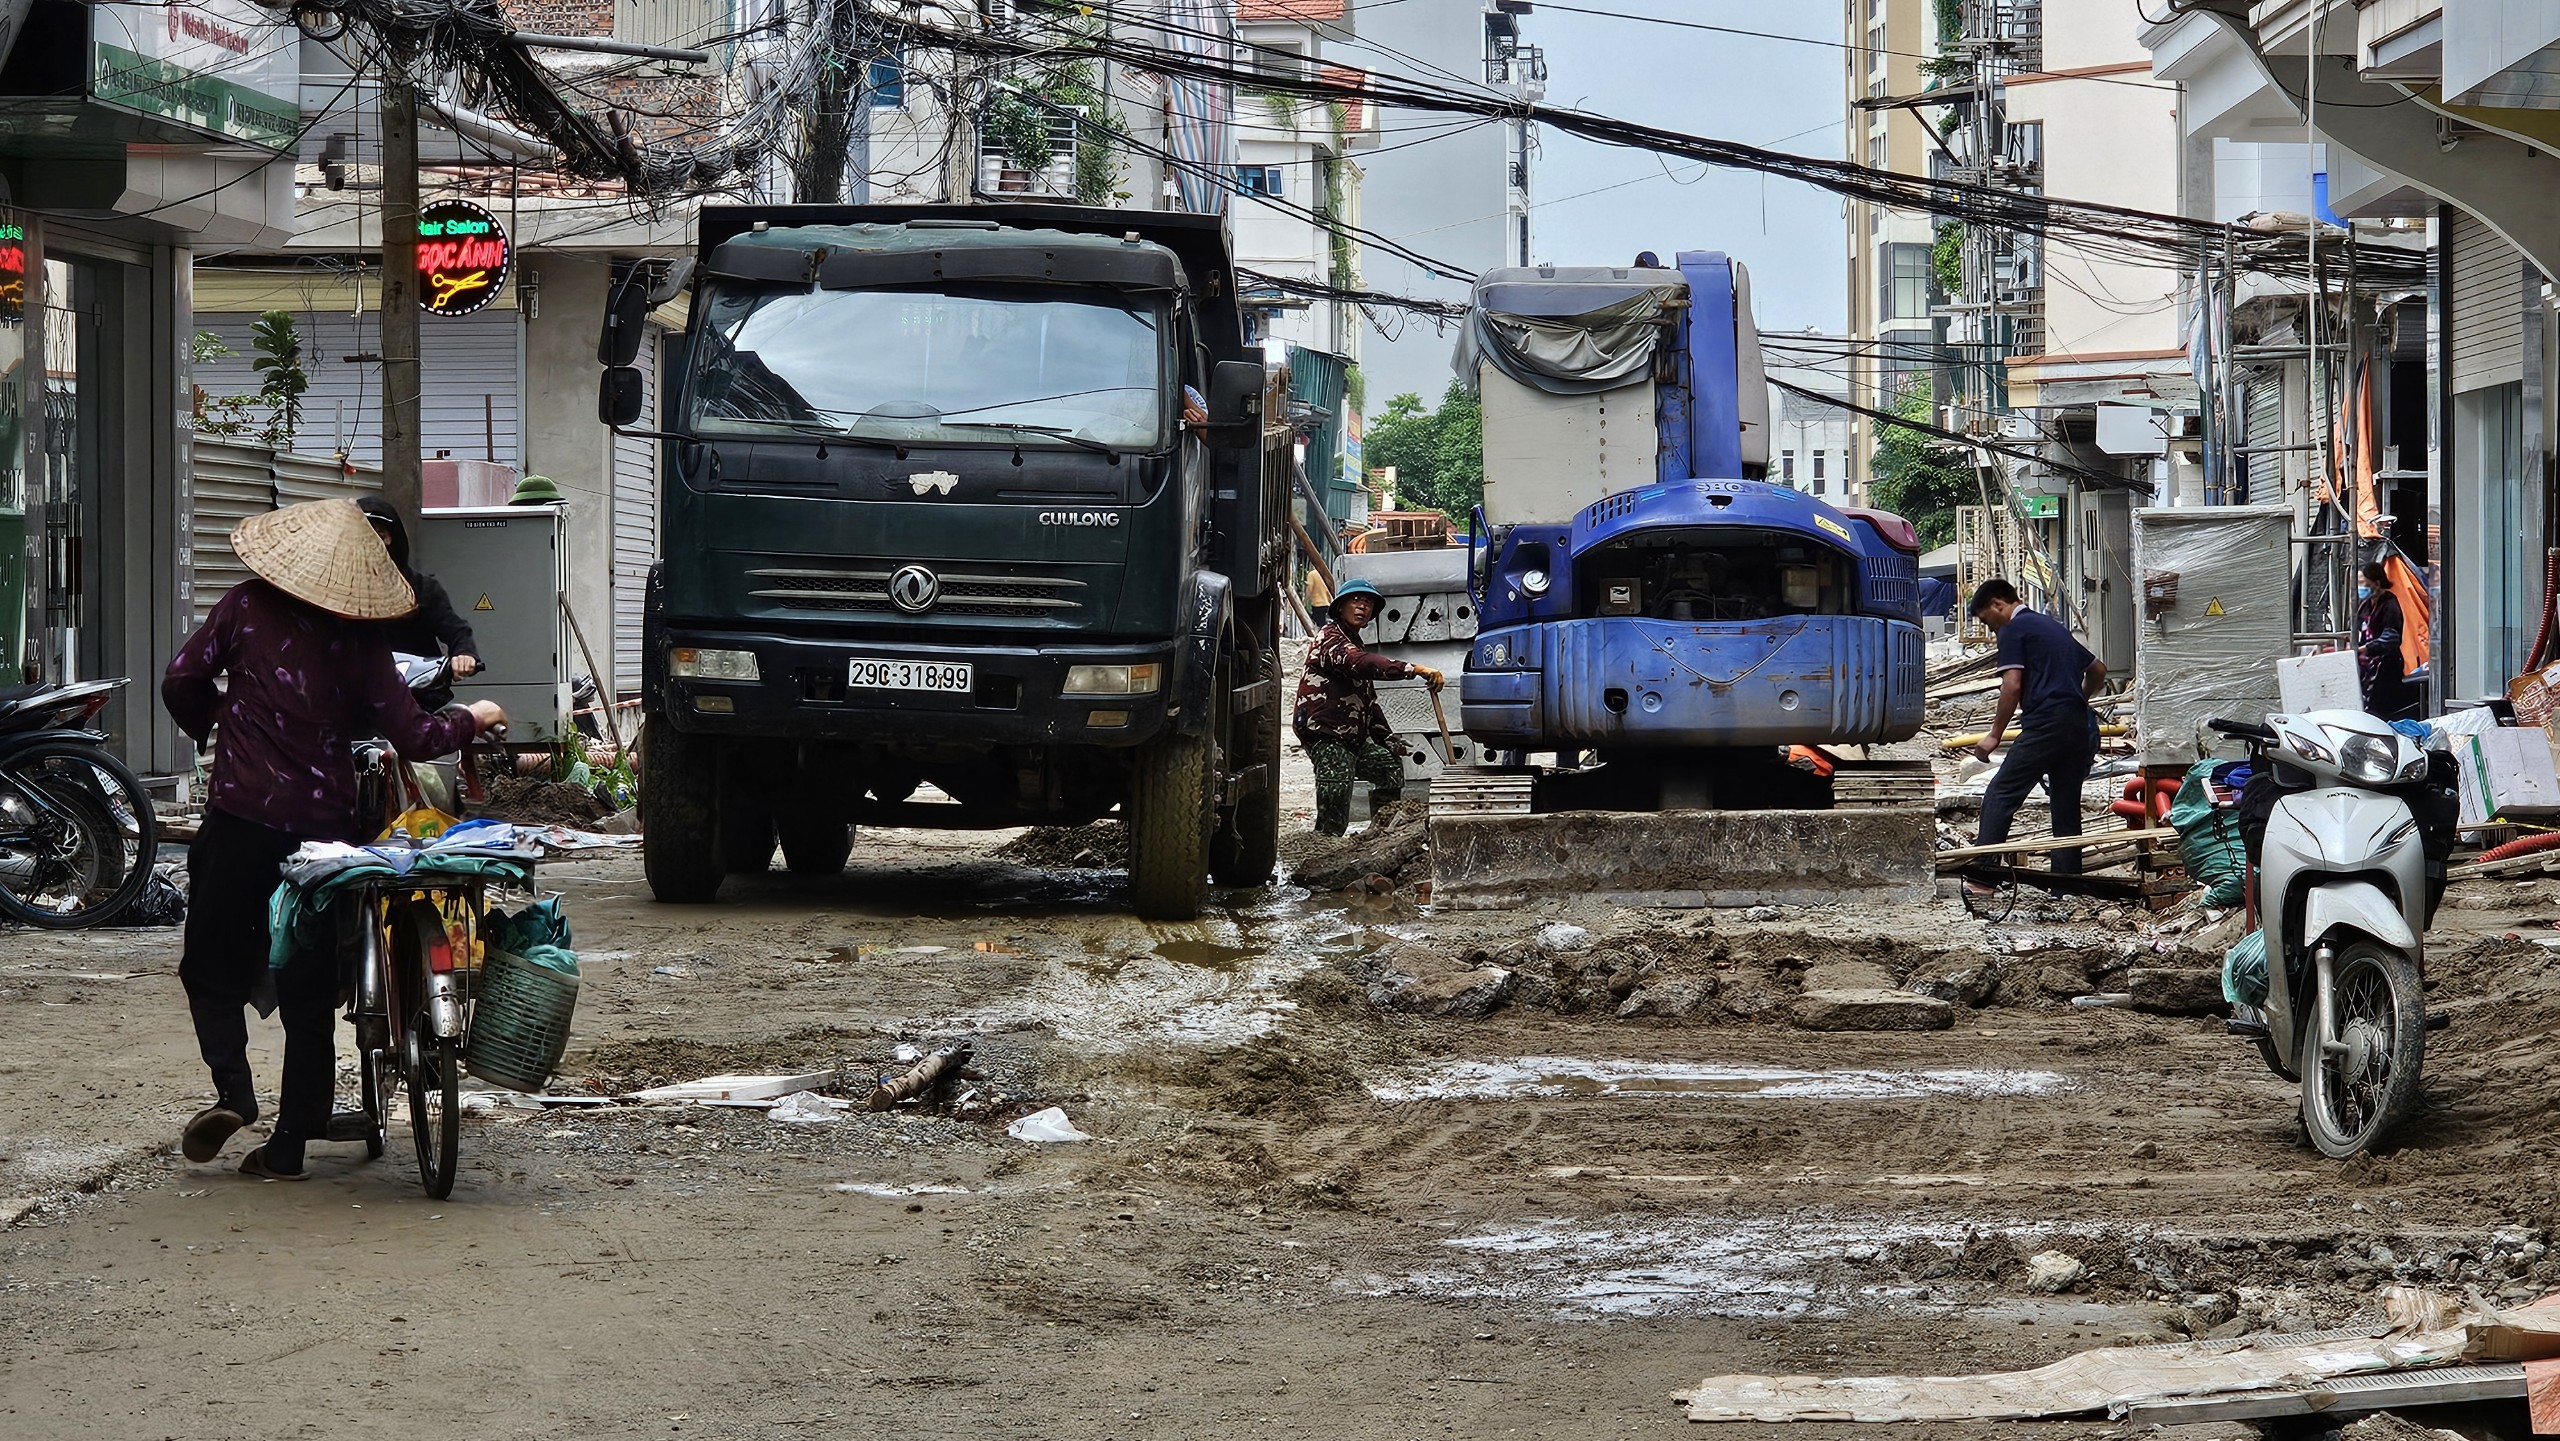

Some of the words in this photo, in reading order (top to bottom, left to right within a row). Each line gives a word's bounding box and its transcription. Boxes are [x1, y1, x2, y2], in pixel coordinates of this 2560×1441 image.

[446, 220, 489, 235] Salon
[418, 242, 457, 275] GỌC
[457, 236, 504, 268] ÁNH
[1039, 512, 1120, 526] CUULONG
